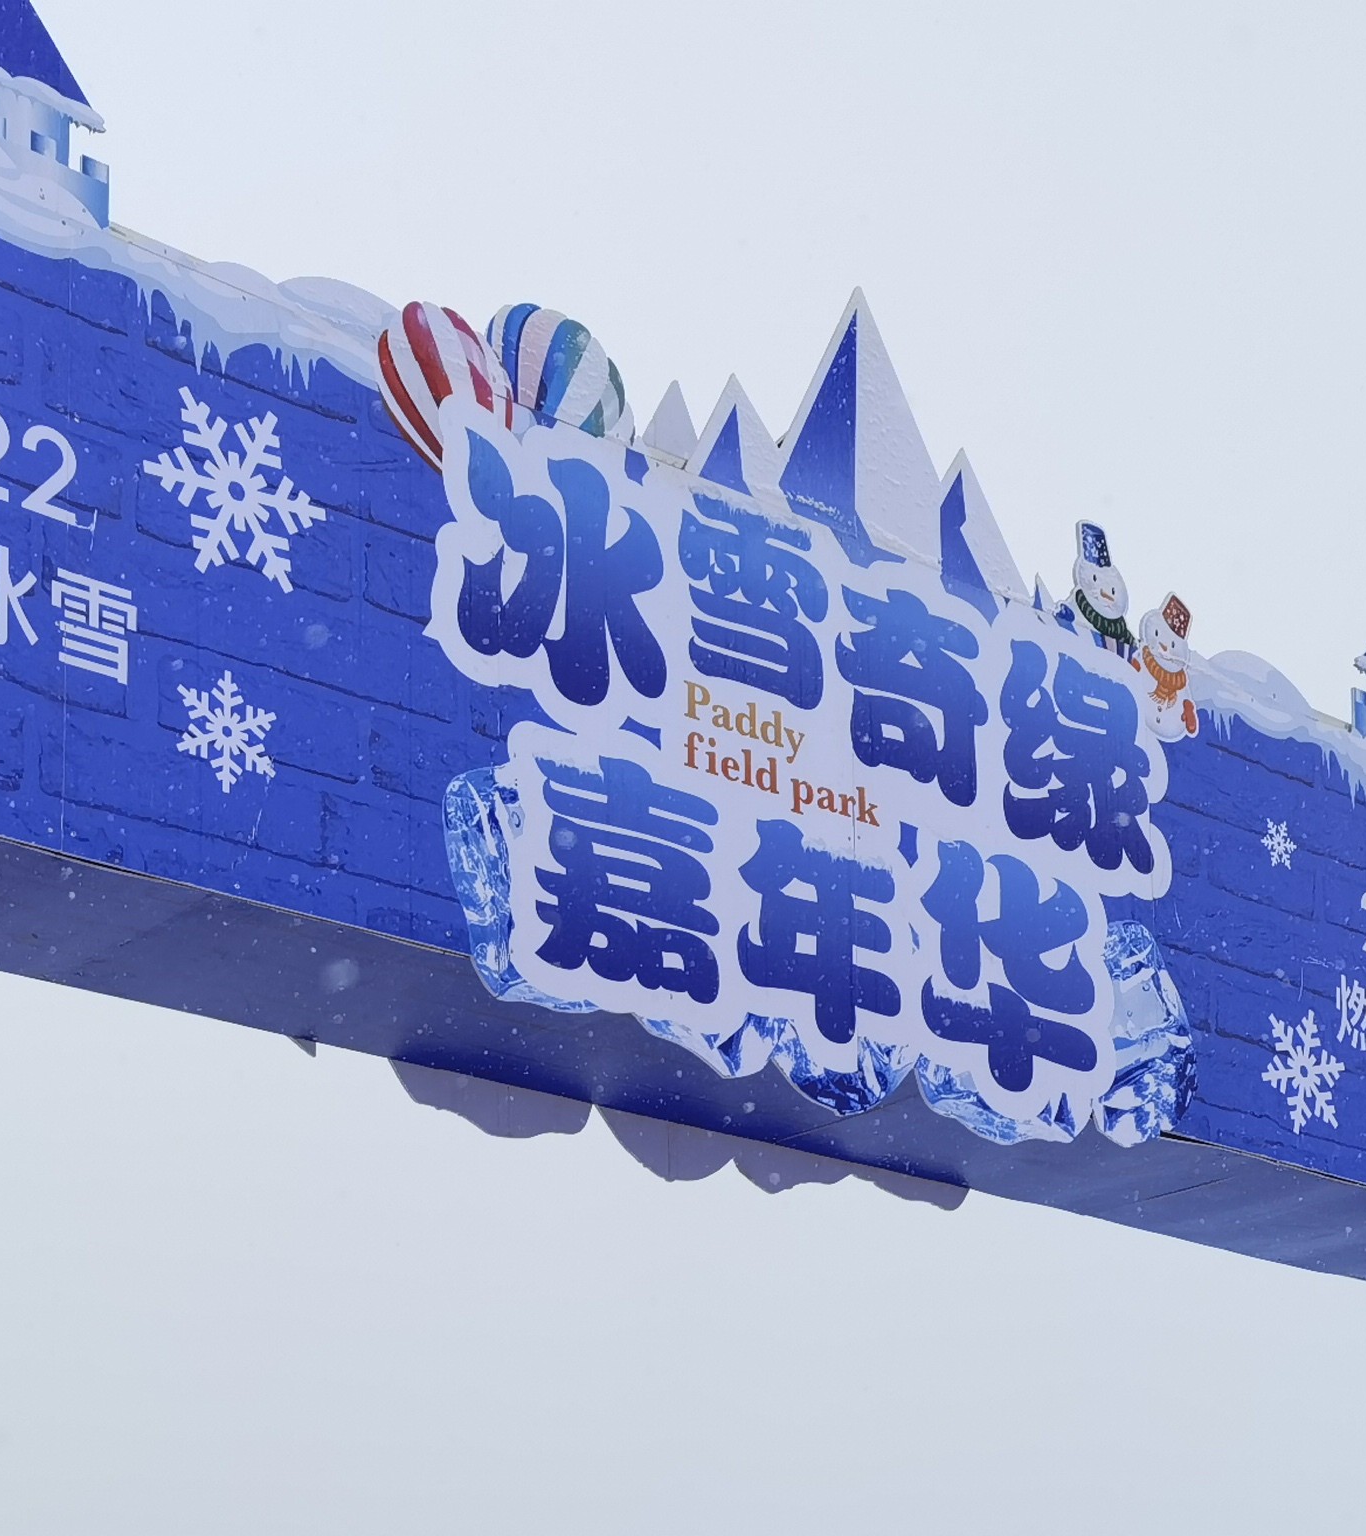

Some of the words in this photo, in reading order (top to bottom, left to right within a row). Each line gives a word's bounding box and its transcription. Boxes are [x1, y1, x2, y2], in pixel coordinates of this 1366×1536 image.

[457, 425, 1155, 874] 冰雪奇缘
[684, 679, 805, 765] Paddy
[684, 732, 779, 795] field
[791, 775, 881, 828] park
[535, 757, 1099, 1092] 嘉年华
